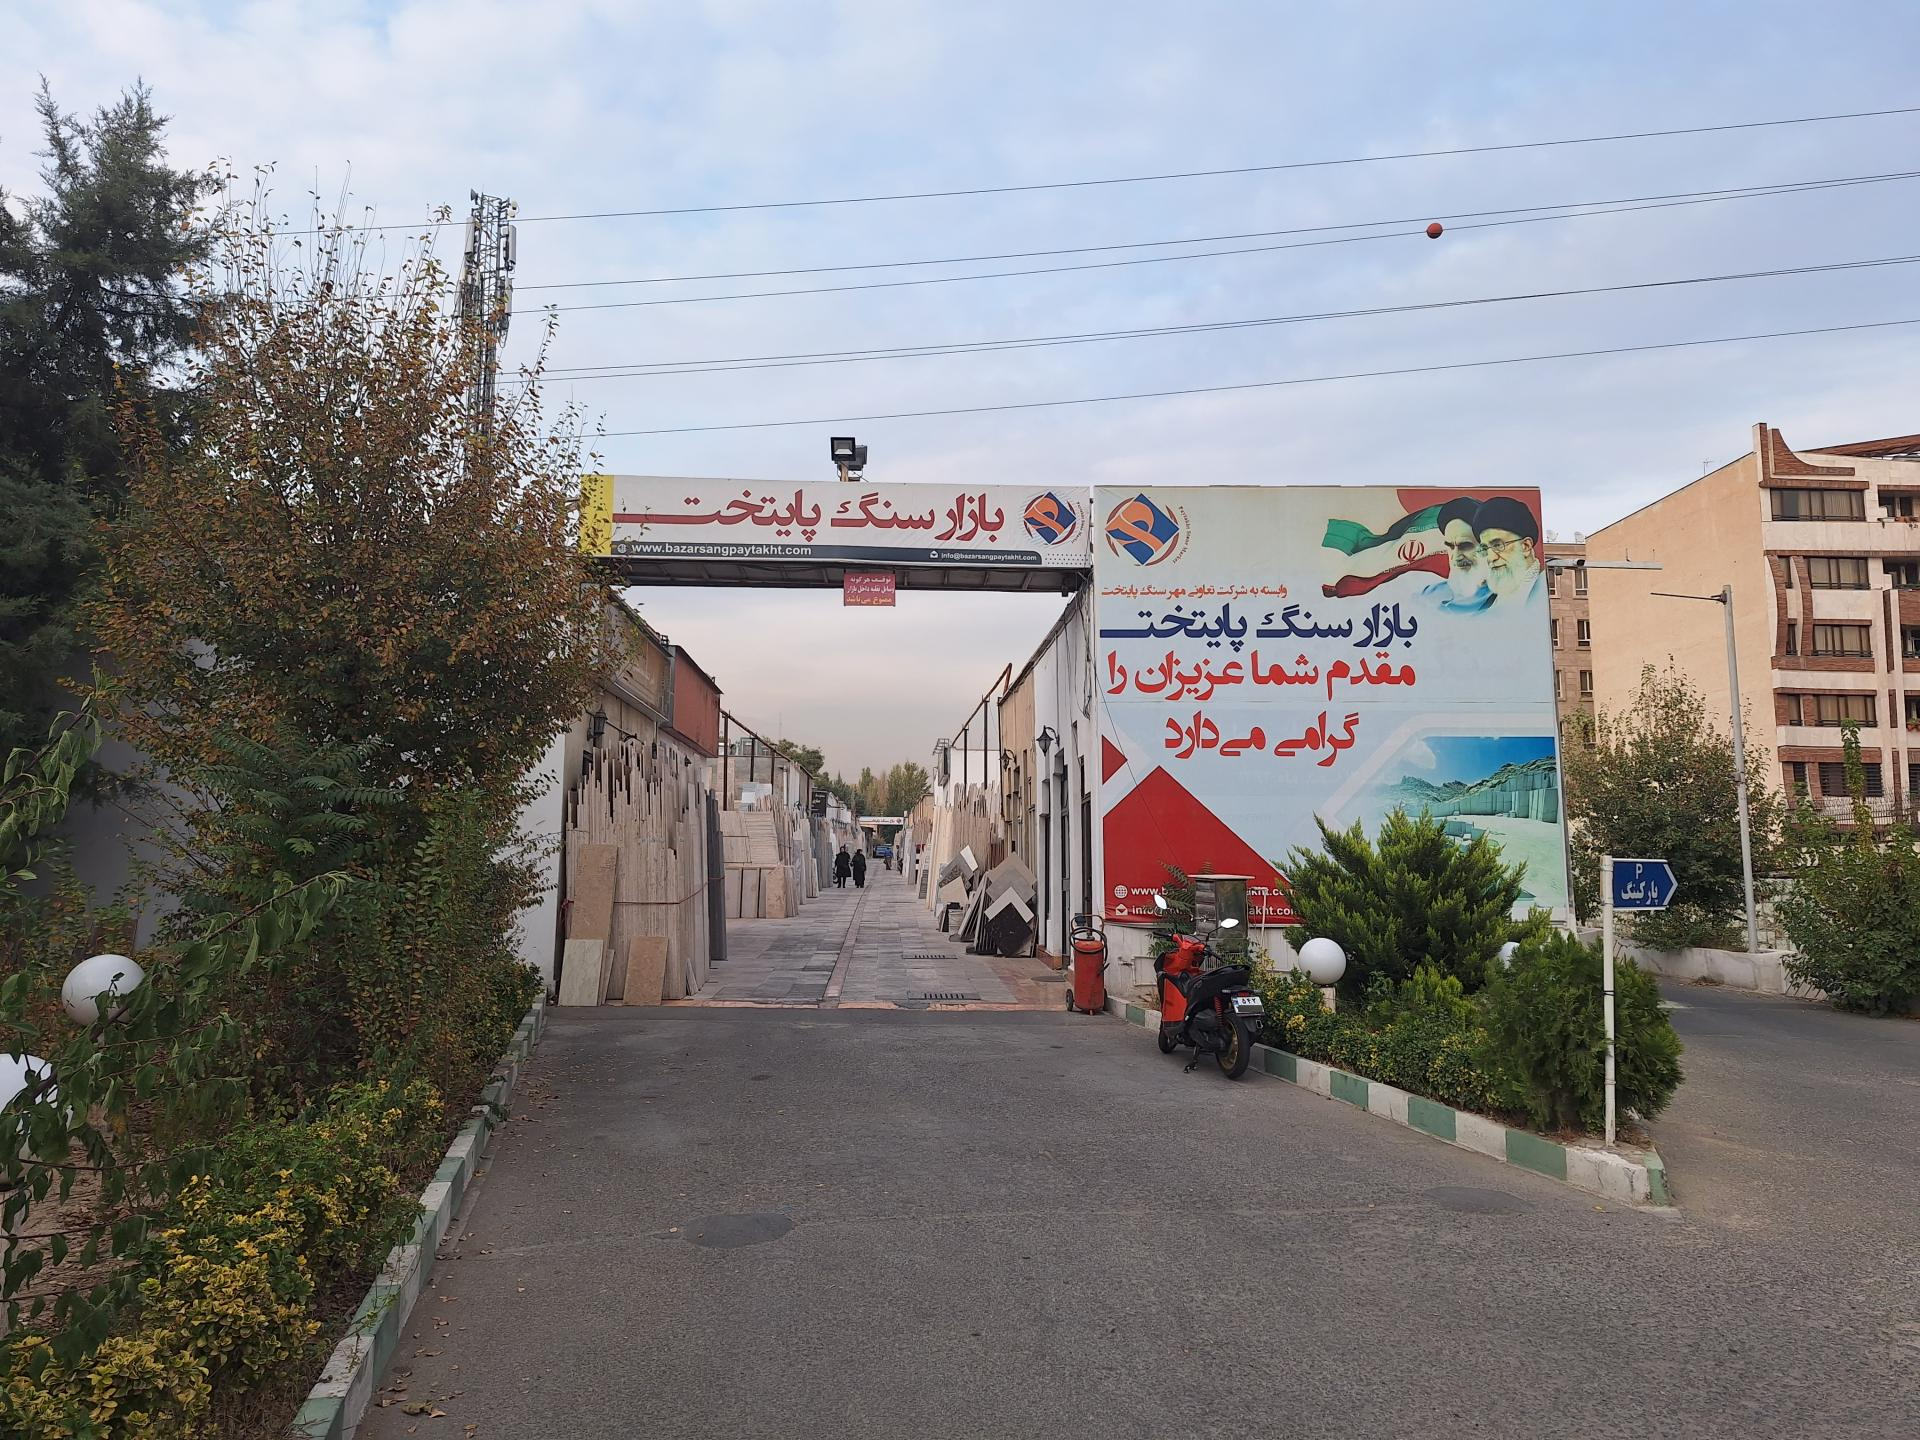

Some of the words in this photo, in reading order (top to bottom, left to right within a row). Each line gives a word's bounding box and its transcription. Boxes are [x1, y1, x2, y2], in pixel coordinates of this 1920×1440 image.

[612, 489, 822, 543] پایتخت
[830, 491, 935, 530] سنگ
[935, 493, 1005, 543] بازار
[631, 543, 812, 557] www.bazarsangpaytakht.com
[941, 552, 1037, 562] info@bazarsangpaytakht.com
[1101, 584, 1139, 600] پایتخت
[1139, 584, 1166, 597] سنگ
[1166, 587, 1186, 600] مهر
[1187, 584, 1215, 599] تعاونی
[1217, 584, 1248, 600] شرکت
[1249, 587, 1260, 598] به
[1260, 584, 1288, 599] وابسته
[1100, 603, 1248, 653] پایتخت
[1256, 604, 1353, 639] سنگ
[1353, 603, 1418, 649] بازار
[1107, 650, 1128, 695] را
[1134, 650, 1245, 701] عزیزان
[1250, 650, 1319, 686] شما
[1326, 651, 1416, 701] مقدم
[1273, 710, 1360, 767] گرامی
[1635, 863, 1643, 880] P
[1620, 880, 1659, 905] پارکینگ
